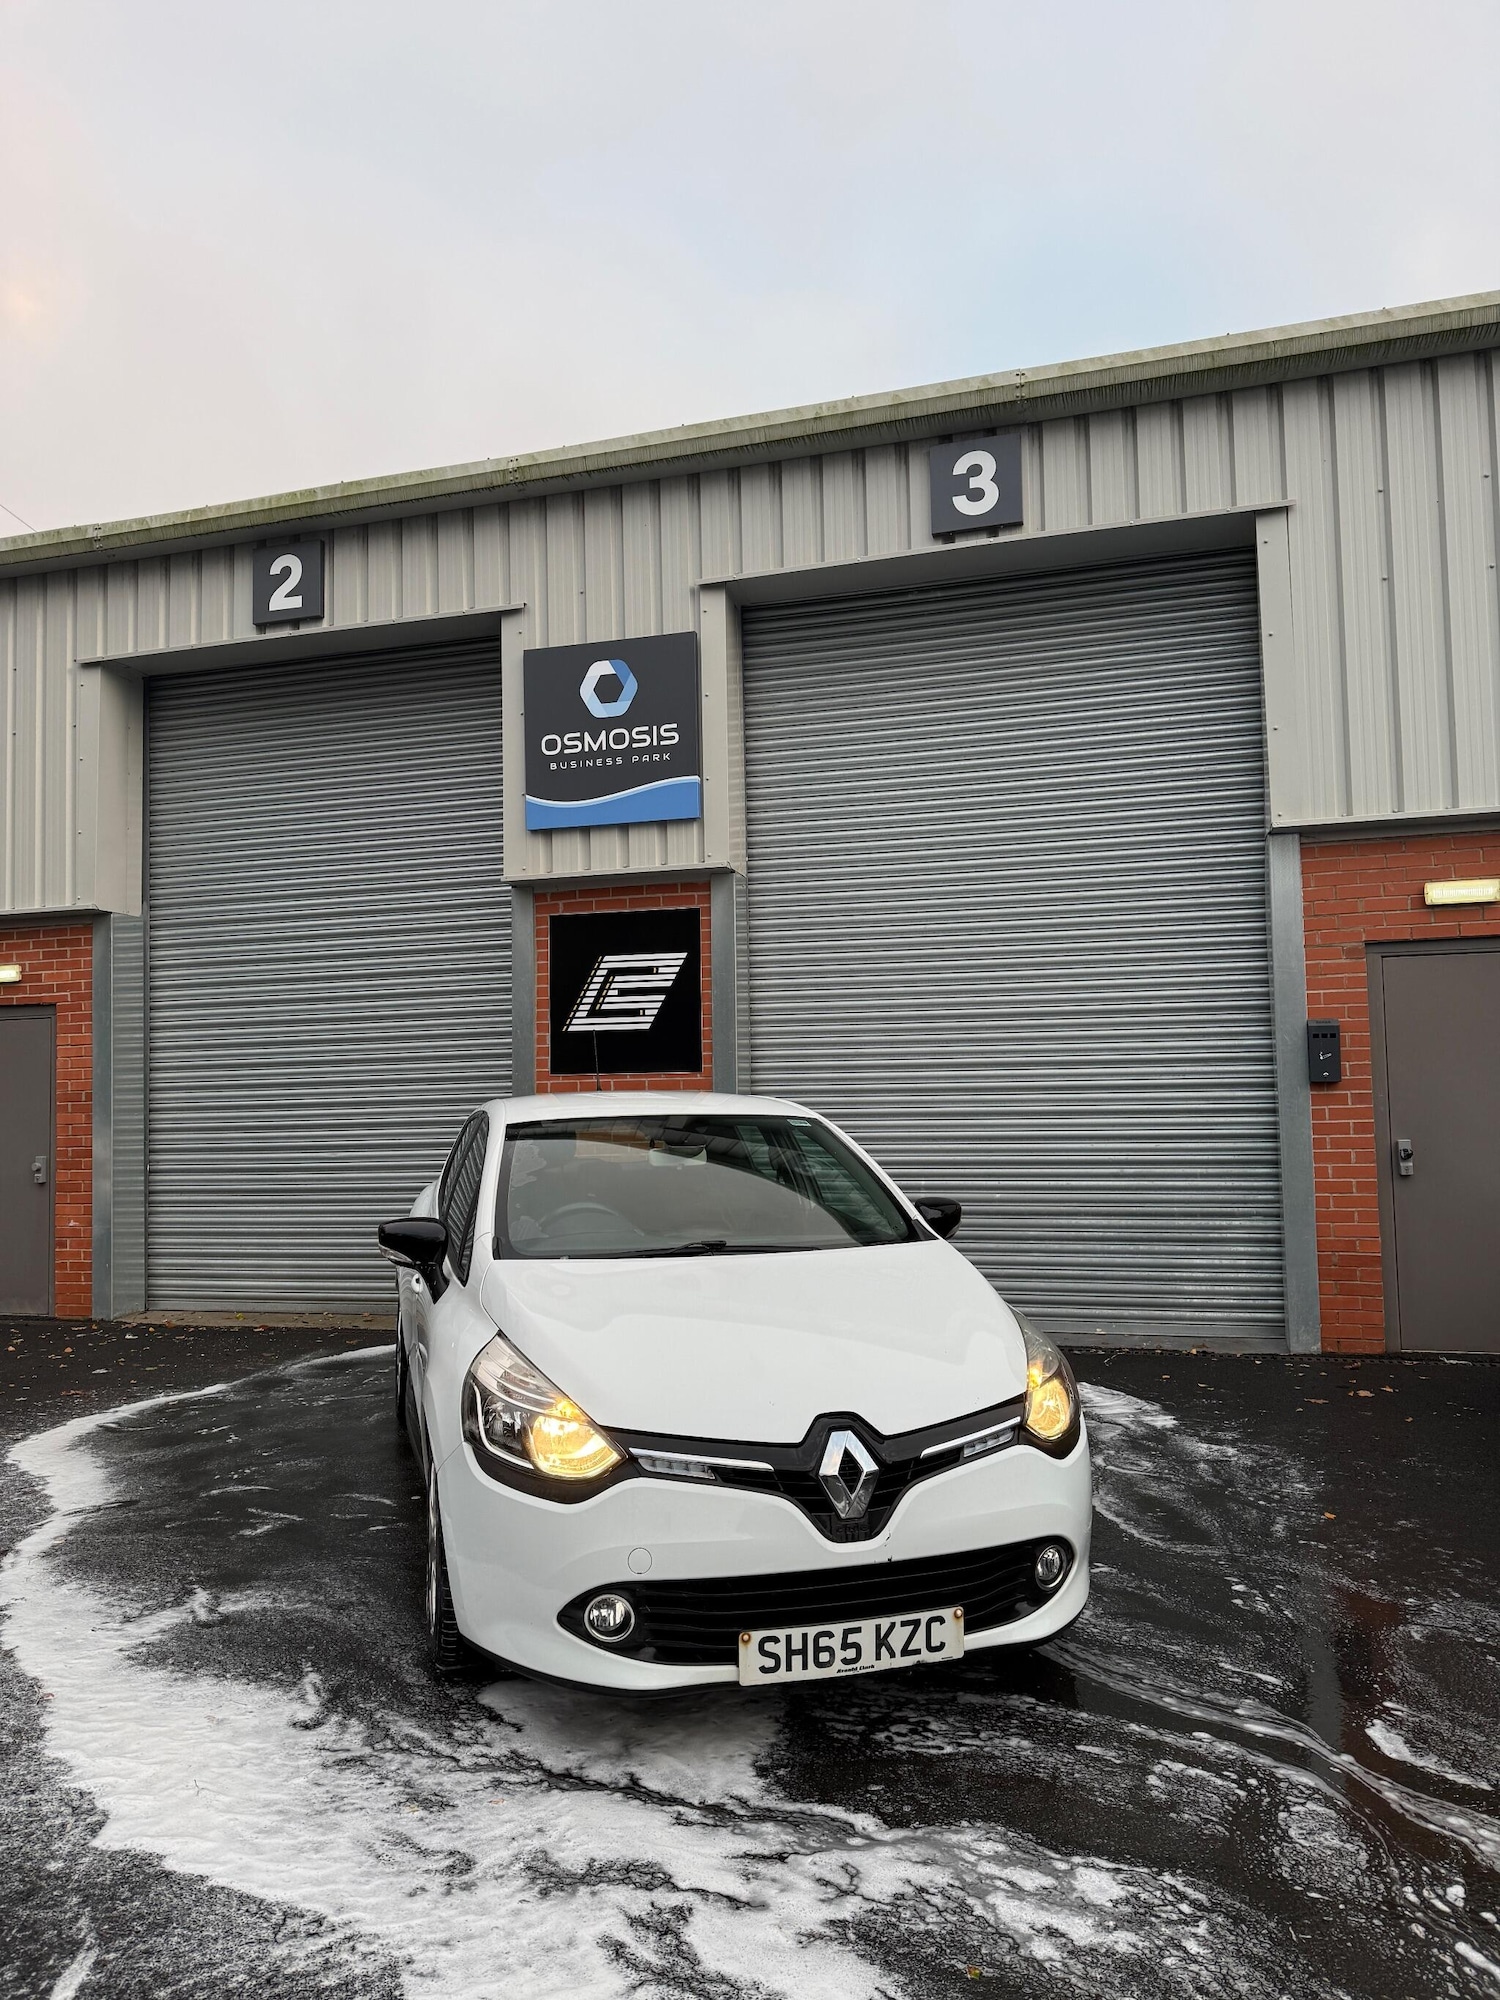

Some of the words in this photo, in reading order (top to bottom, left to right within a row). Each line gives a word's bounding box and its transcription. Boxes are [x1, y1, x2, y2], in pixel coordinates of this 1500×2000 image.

[952, 450, 999, 516] 3
[269, 554, 302, 611] 2
[541, 723, 680, 756] OSMOSIS
[550, 756, 623, 770] BUSINESS
[632, 752, 671, 764] PARK
[758, 1626, 862, 1674] SH65
[875, 1615, 946, 1661] KZC
